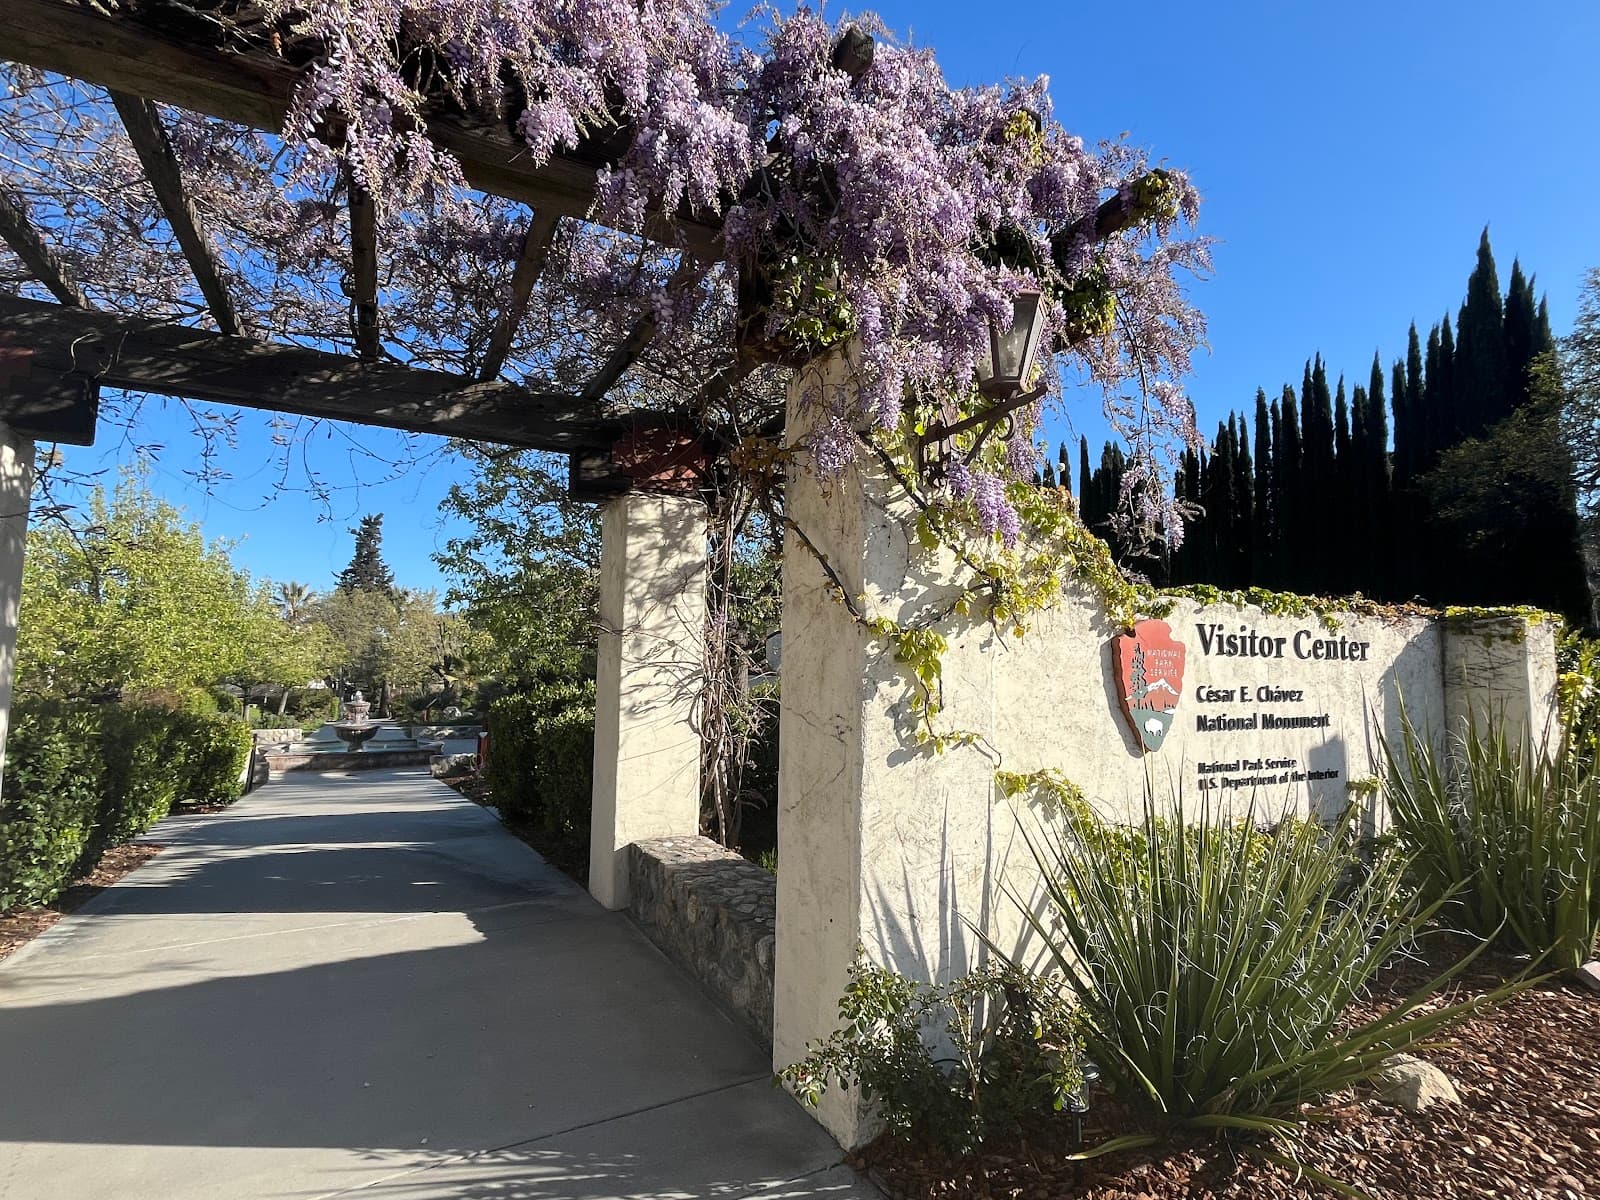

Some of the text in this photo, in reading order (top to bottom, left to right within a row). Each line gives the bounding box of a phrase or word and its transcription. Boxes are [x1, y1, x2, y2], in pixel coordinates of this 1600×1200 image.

[1195, 624, 1370, 661] Visitor Center
[1147, 649, 1181, 658] NATIONAL
[1150, 668, 1177, 677] SERVICE
[1196, 685, 1303, 703] César E. Chávez
[1196, 713, 1330, 732] National Monument
[1198, 758, 1297, 774] National Park Service
[1198, 768, 1339, 791] U.S. Department of the Interior
